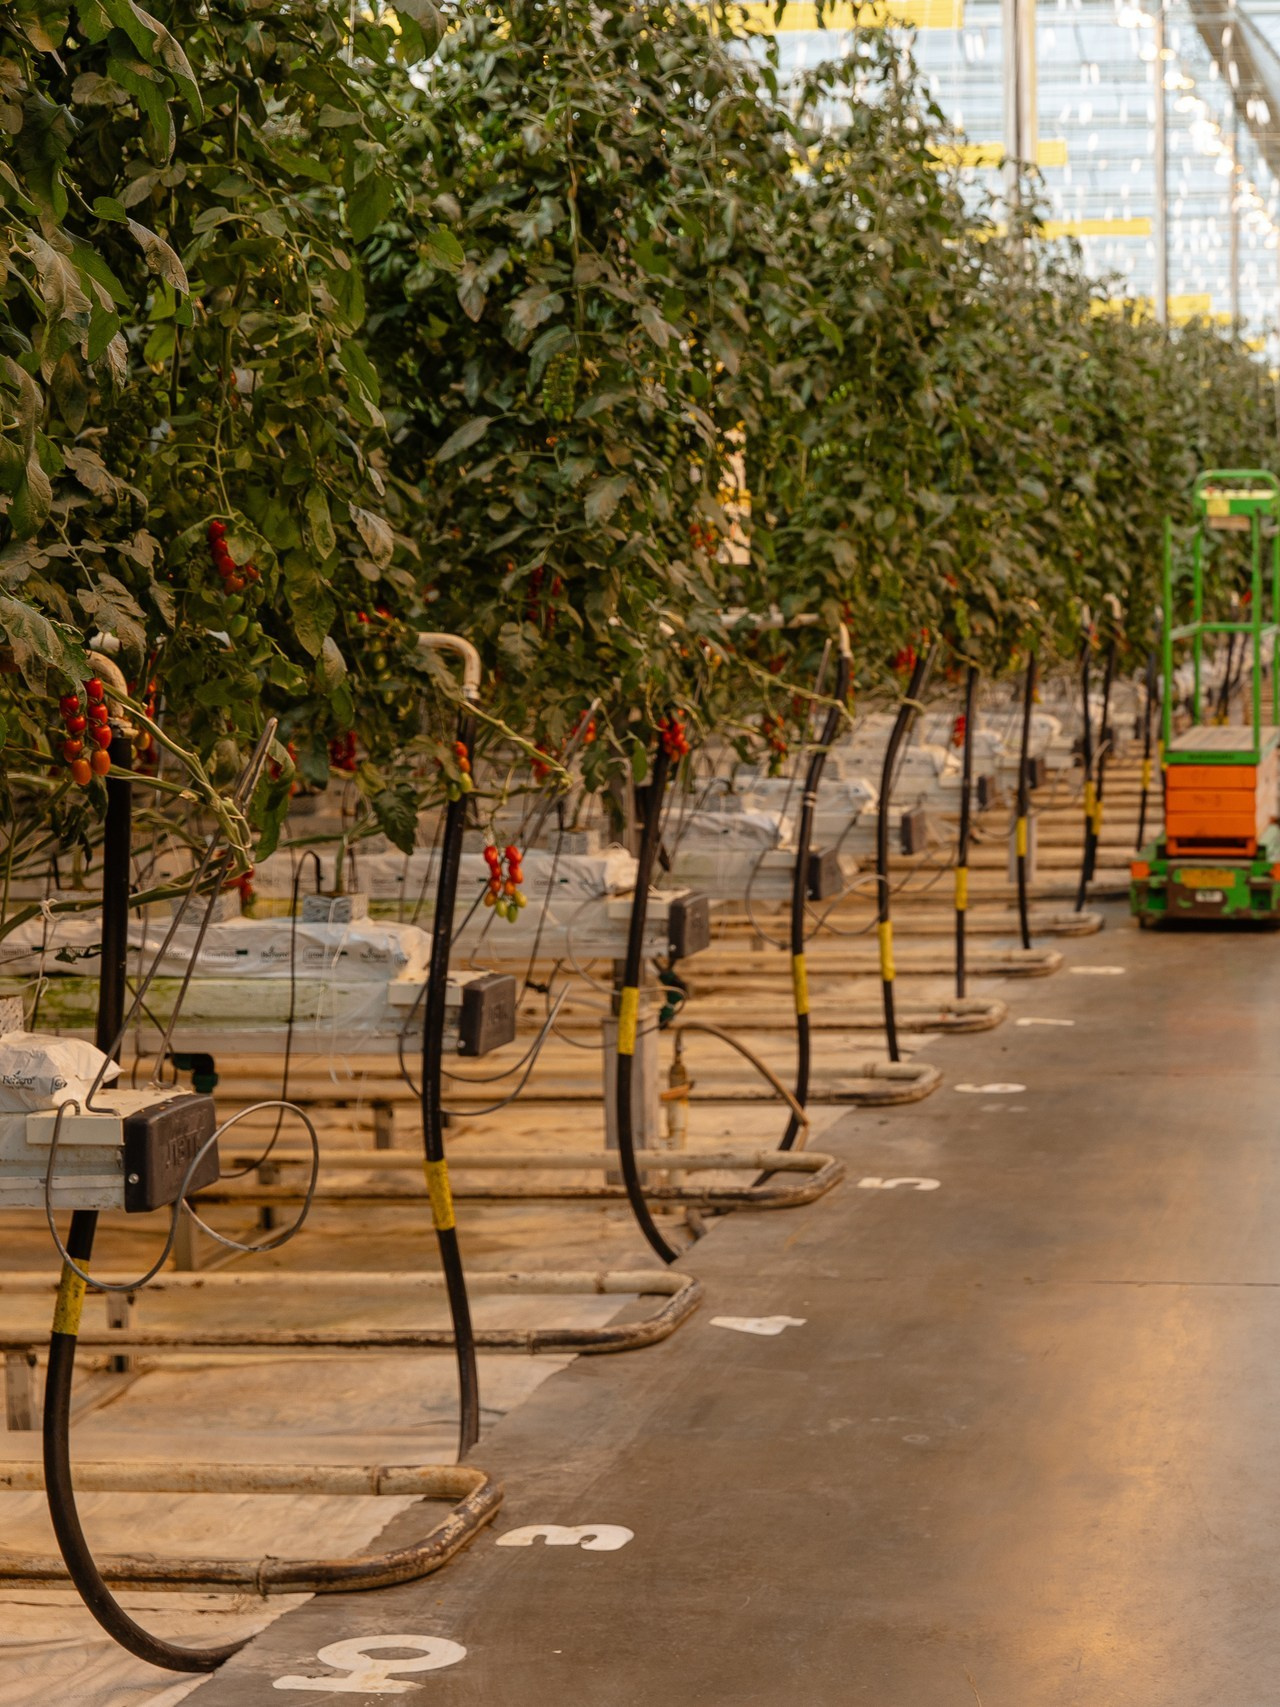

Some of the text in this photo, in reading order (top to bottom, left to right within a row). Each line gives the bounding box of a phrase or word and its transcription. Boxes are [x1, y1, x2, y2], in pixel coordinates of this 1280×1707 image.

[857, 1177, 941, 1191] 5
[709, 1315, 806, 1336] 4
[495, 1524, 634, 1551] 3
